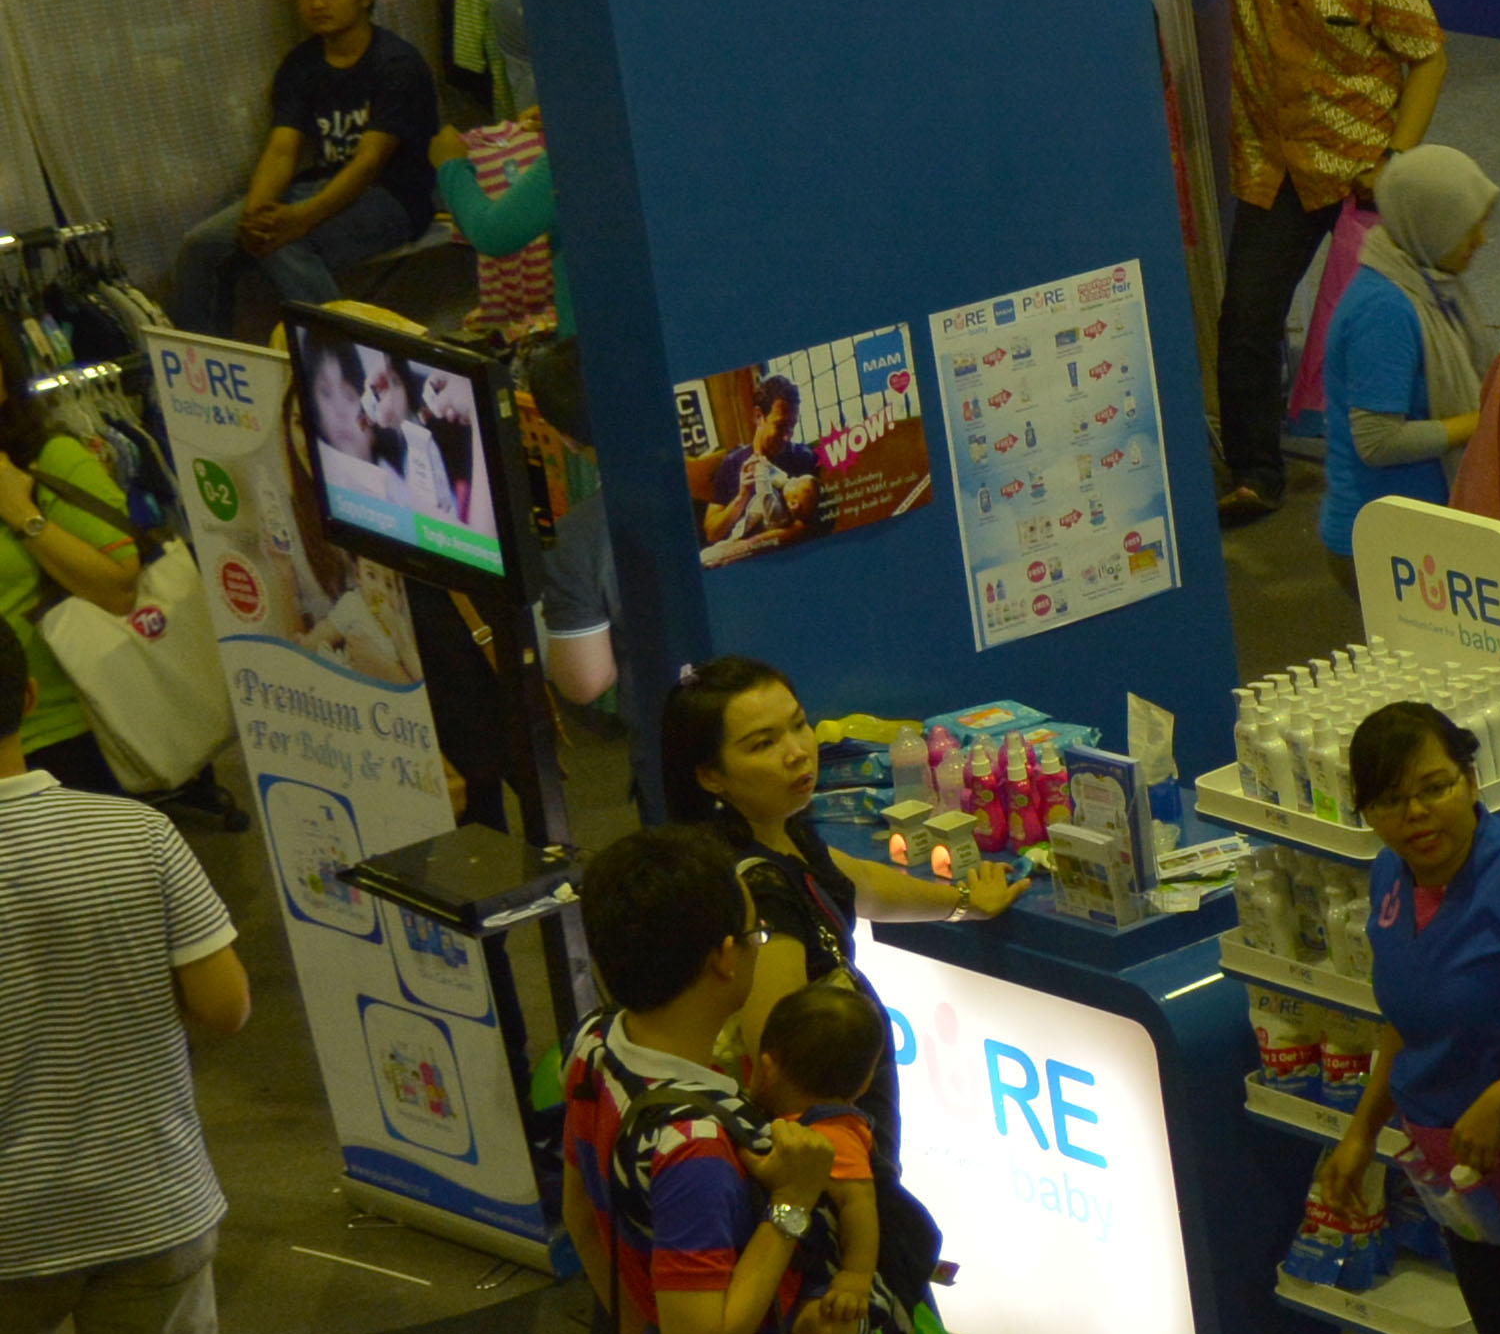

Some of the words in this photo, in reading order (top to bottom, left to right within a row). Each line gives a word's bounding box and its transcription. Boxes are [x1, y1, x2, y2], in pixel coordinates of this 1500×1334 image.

[162, 346, 254, 405] PURE
[862, 351, 901, 373] MAM
[824, 402, 896, 468] WOW!
[234, 665, 362, 733] Premium
[371, 701, 432, 750] Care
